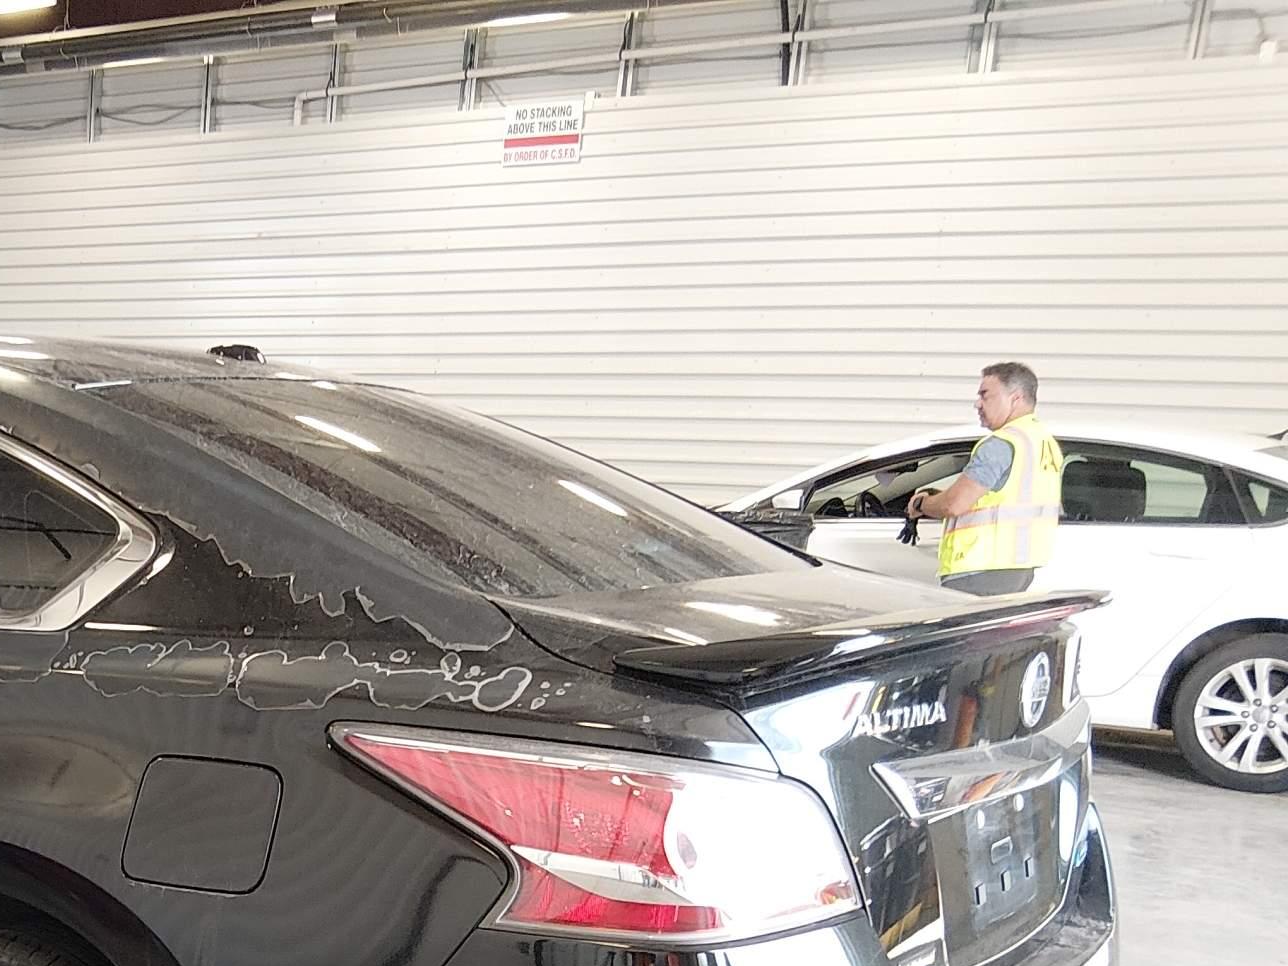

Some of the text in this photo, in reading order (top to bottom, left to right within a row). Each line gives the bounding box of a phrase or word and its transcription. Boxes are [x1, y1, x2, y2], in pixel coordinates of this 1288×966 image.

[516, 105, 573, 120] NO STACKING
[507, 119, 579, 135] ABOVE THIS LINE
[504, 152, 513, 162] BY
[514, 150, 538, 162] ORDER
[540, 149, 549, 160] OF
[852, 701, 948, 738] ALTIMA
